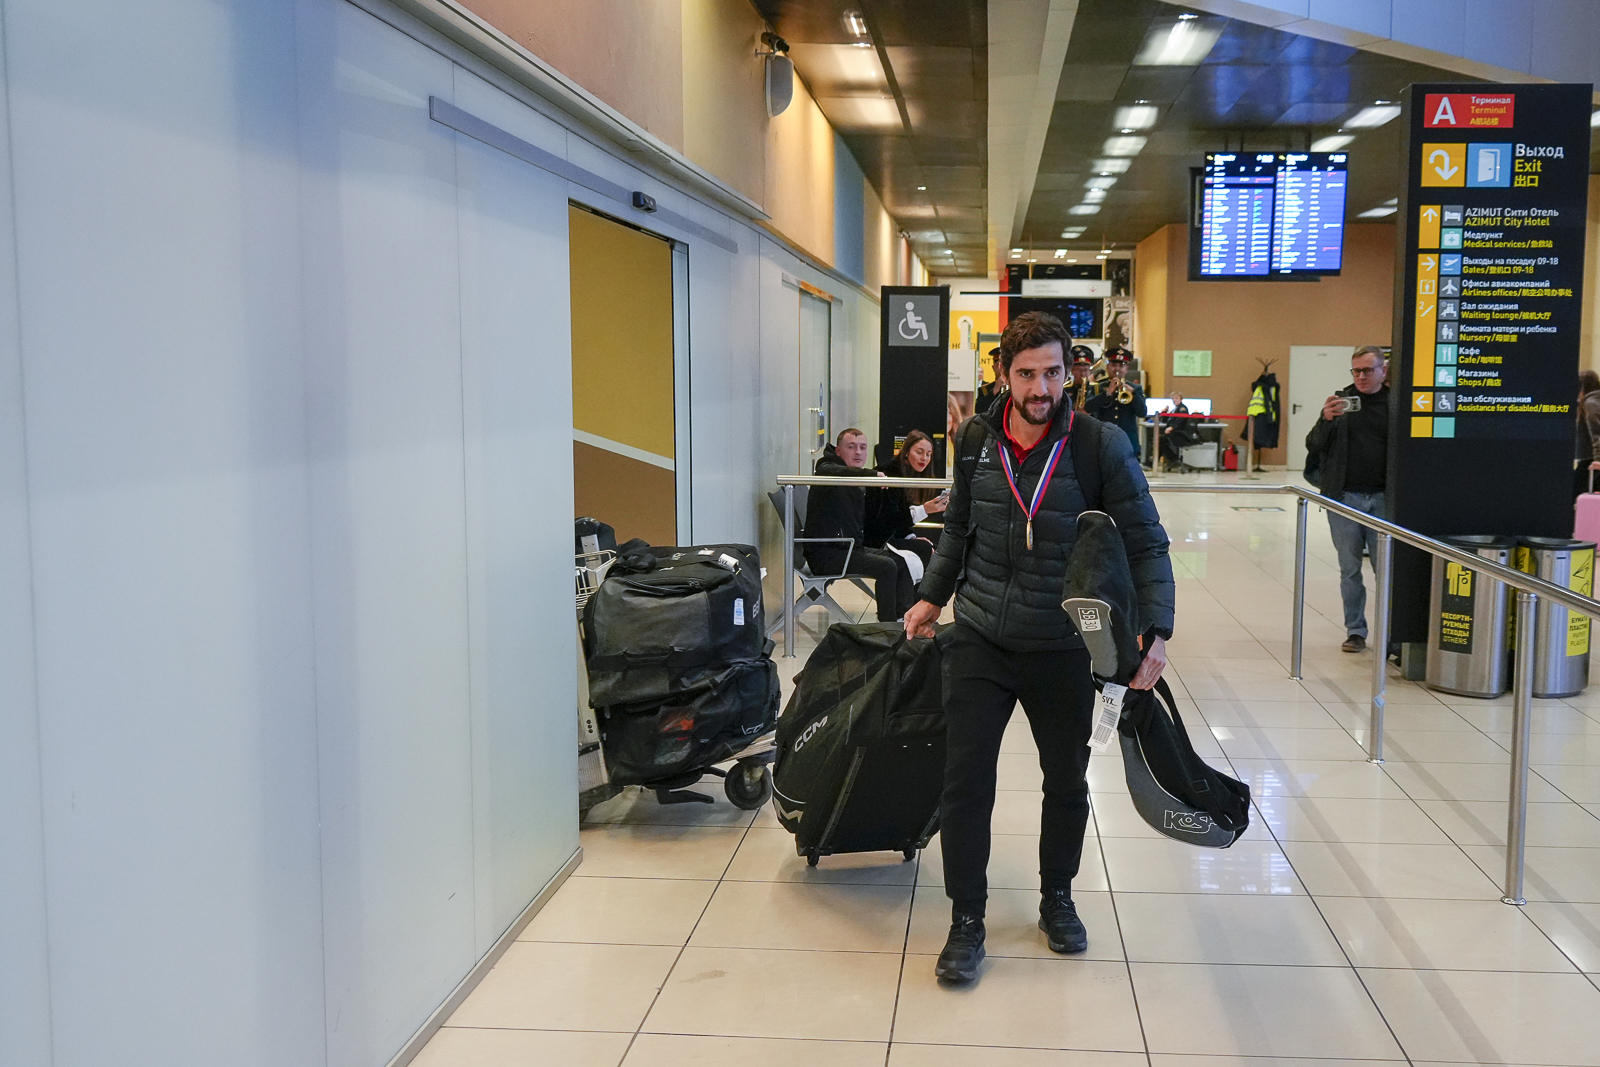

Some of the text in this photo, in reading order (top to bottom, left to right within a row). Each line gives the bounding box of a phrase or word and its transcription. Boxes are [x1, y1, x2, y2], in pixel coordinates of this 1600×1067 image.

[1471, 96, 1511, 105] Терминал
[1432, 96, 1456, 125] A
[1515, 144, 1564, 158] Выход
[1514, 159, 1542, 172] Exit
[1514, 174, 1539, 187] 出口
[1465, 208, 1559, 216] AZIMUT Сити Отель
[1464, 217, 1550, 228] AZIMUT City Hotel
[1464, 230, 1503, 240] Медпункт
[1463, 257, 1494, 265] Выходы
[1462, 280, 1489, 288] Офисы
[1461, 311, 1490, 320] Waiting
[1526, 325, 1557, 334] ребенка
[1459, 347, 1480, 355] Кафе
[1458, 369, 1498, 377] Магазины
[1457, 394, 1532, 404] Зал обслуживания
[1443, 620, 1470, 630] РУЕМЫЕ
[1442, 628, 1470, 637] ОТХОДЫ
[1443, 635, 1468, 645] OTHERS
[1102, 695, 1114, 705] SVX
[794, 715, 828, 752] CCM
